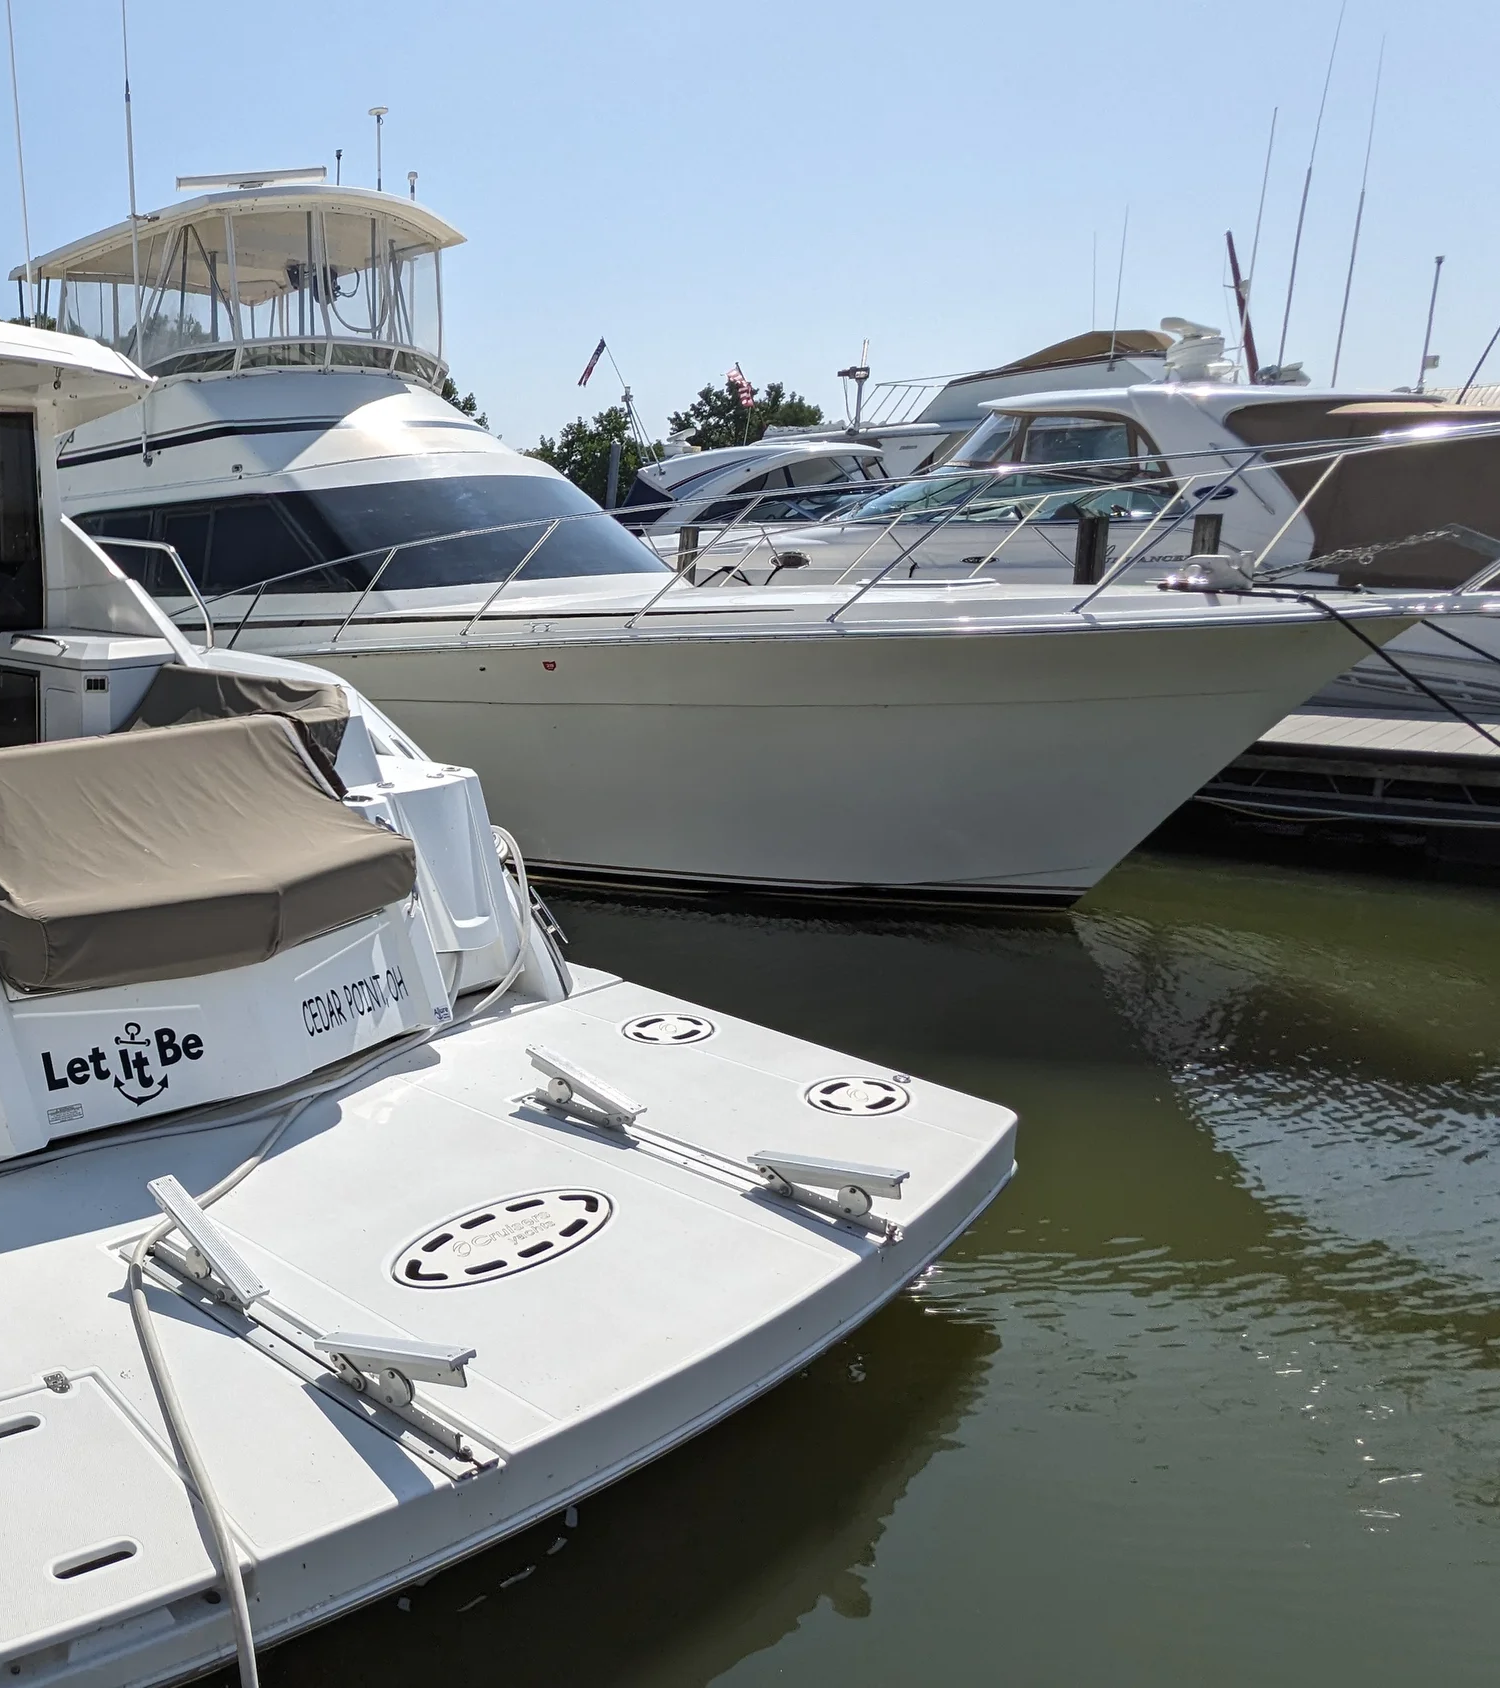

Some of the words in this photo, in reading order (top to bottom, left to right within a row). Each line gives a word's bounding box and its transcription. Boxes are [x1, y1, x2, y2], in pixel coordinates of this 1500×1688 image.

[302, 989, 347, 1037] CEDAR
[343, 974, 390, 1019] POINT,
[386, 965, 409, 1001] OH
[41, 1046, 111, 1091] Let
[118, 1048, 155, 1089] It
[154, 1027, 204, 1067] Be
[471, 1211, 551, 1246] Cruisers
